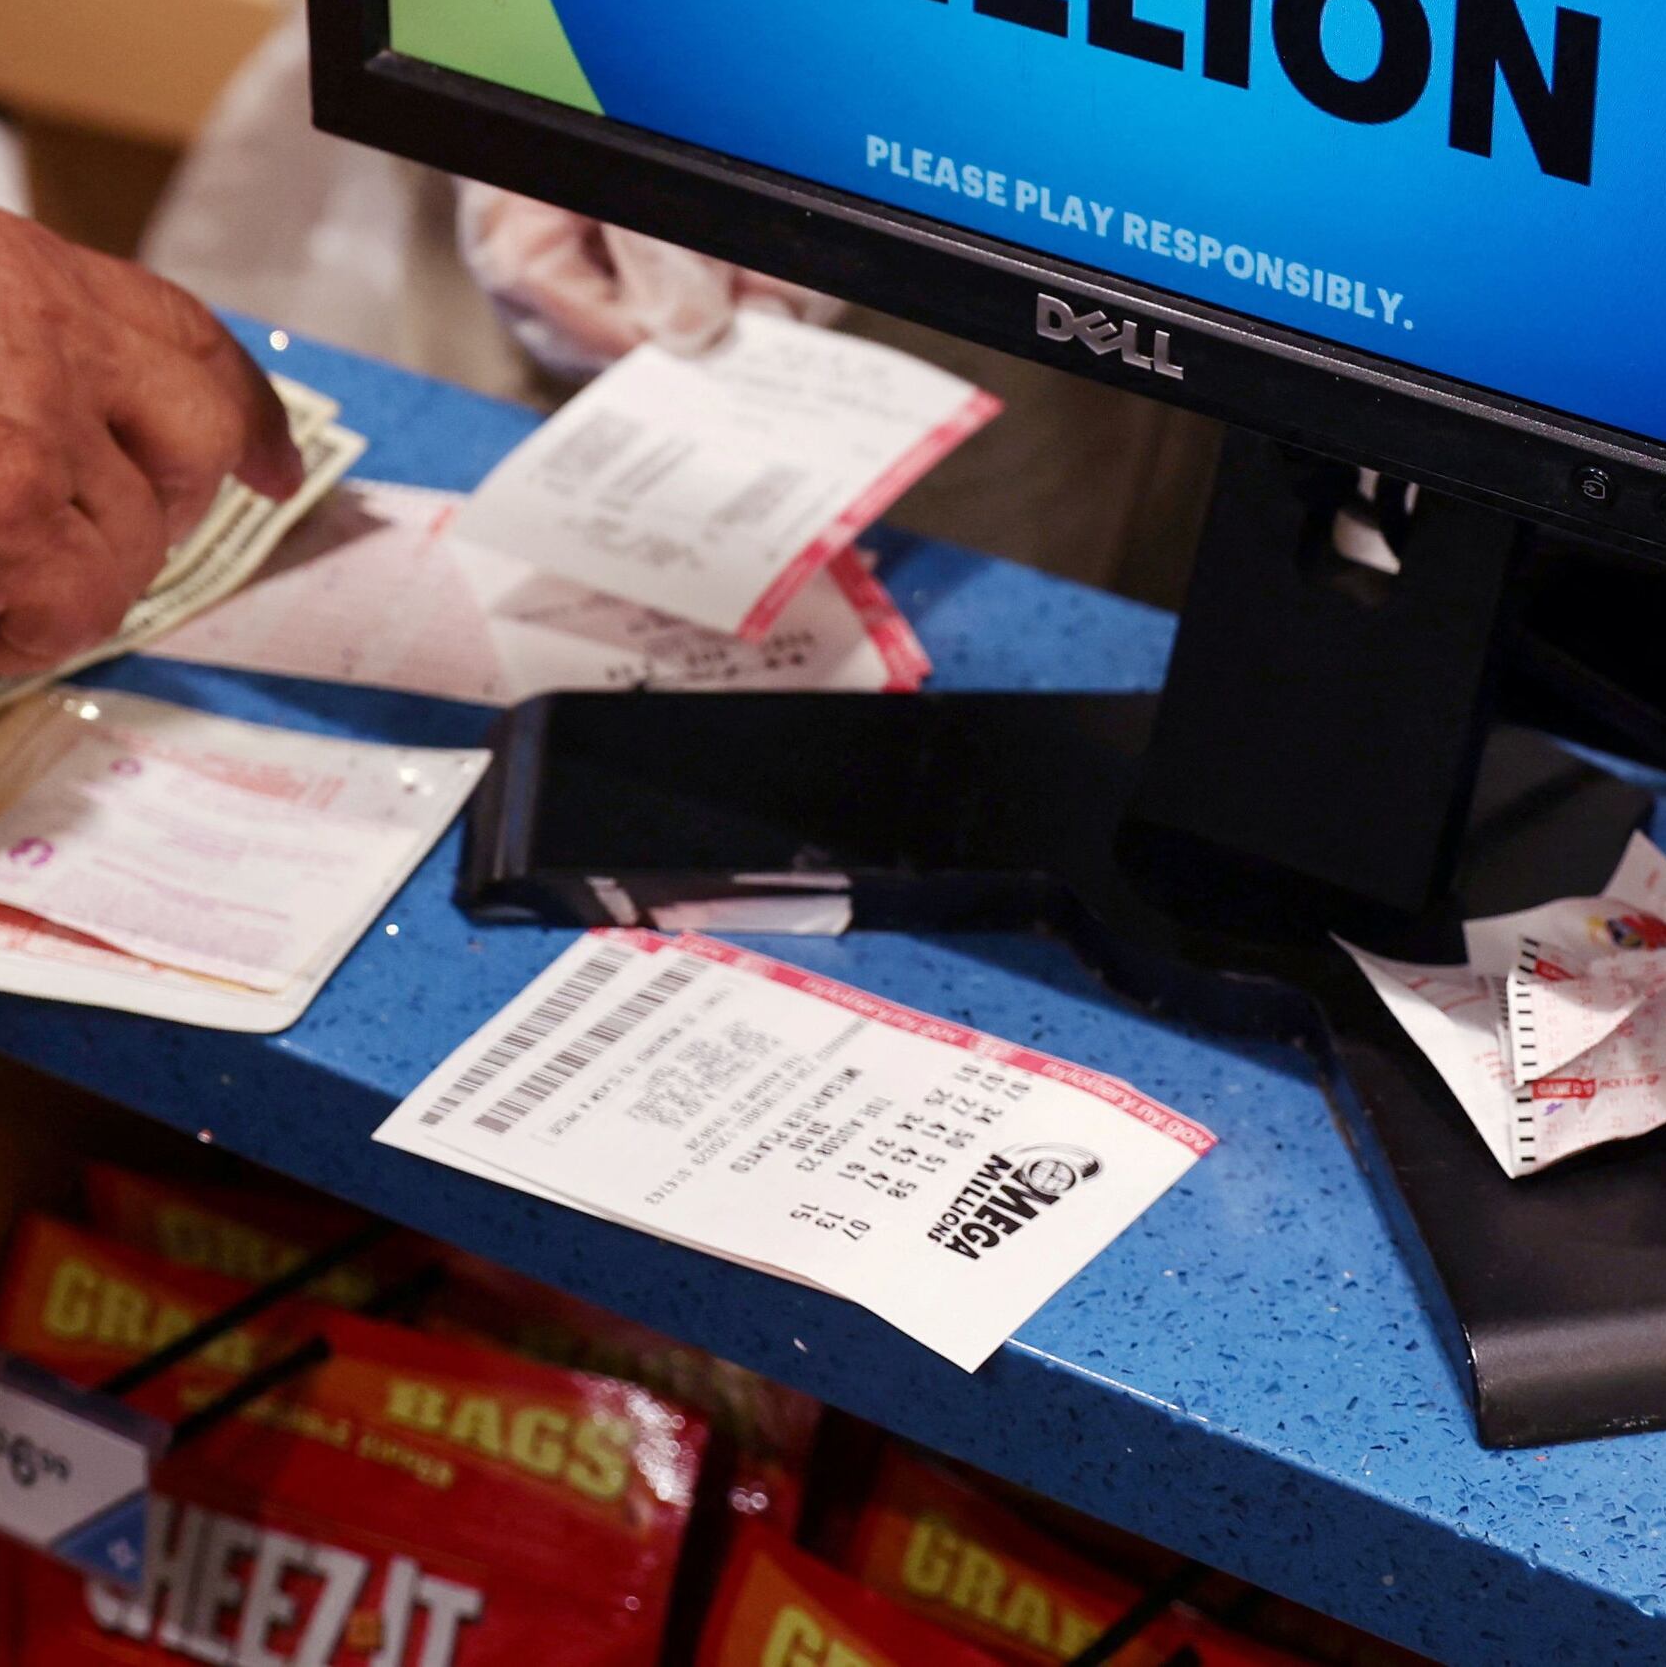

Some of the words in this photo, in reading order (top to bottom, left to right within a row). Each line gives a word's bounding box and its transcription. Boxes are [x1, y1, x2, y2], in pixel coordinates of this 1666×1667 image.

[865, 134, 1007, 208] PLEASE
[1015, 179, 1115, 238] PLAY
[1122, 211, 1415, 331] RESPONSIBLY.
[1035, 292, 1185, 381] DELL
[790, 1204, 820, 1220] 15
[815, 1212, 845, 1230] 13
[842, 1220, 871, 1241] 07
[927, 1153, 1013, 1245] MILLIONS
[944, 1171, 1061, 1261] MEGA
[386, 1379, 632, 1502] BAGS
